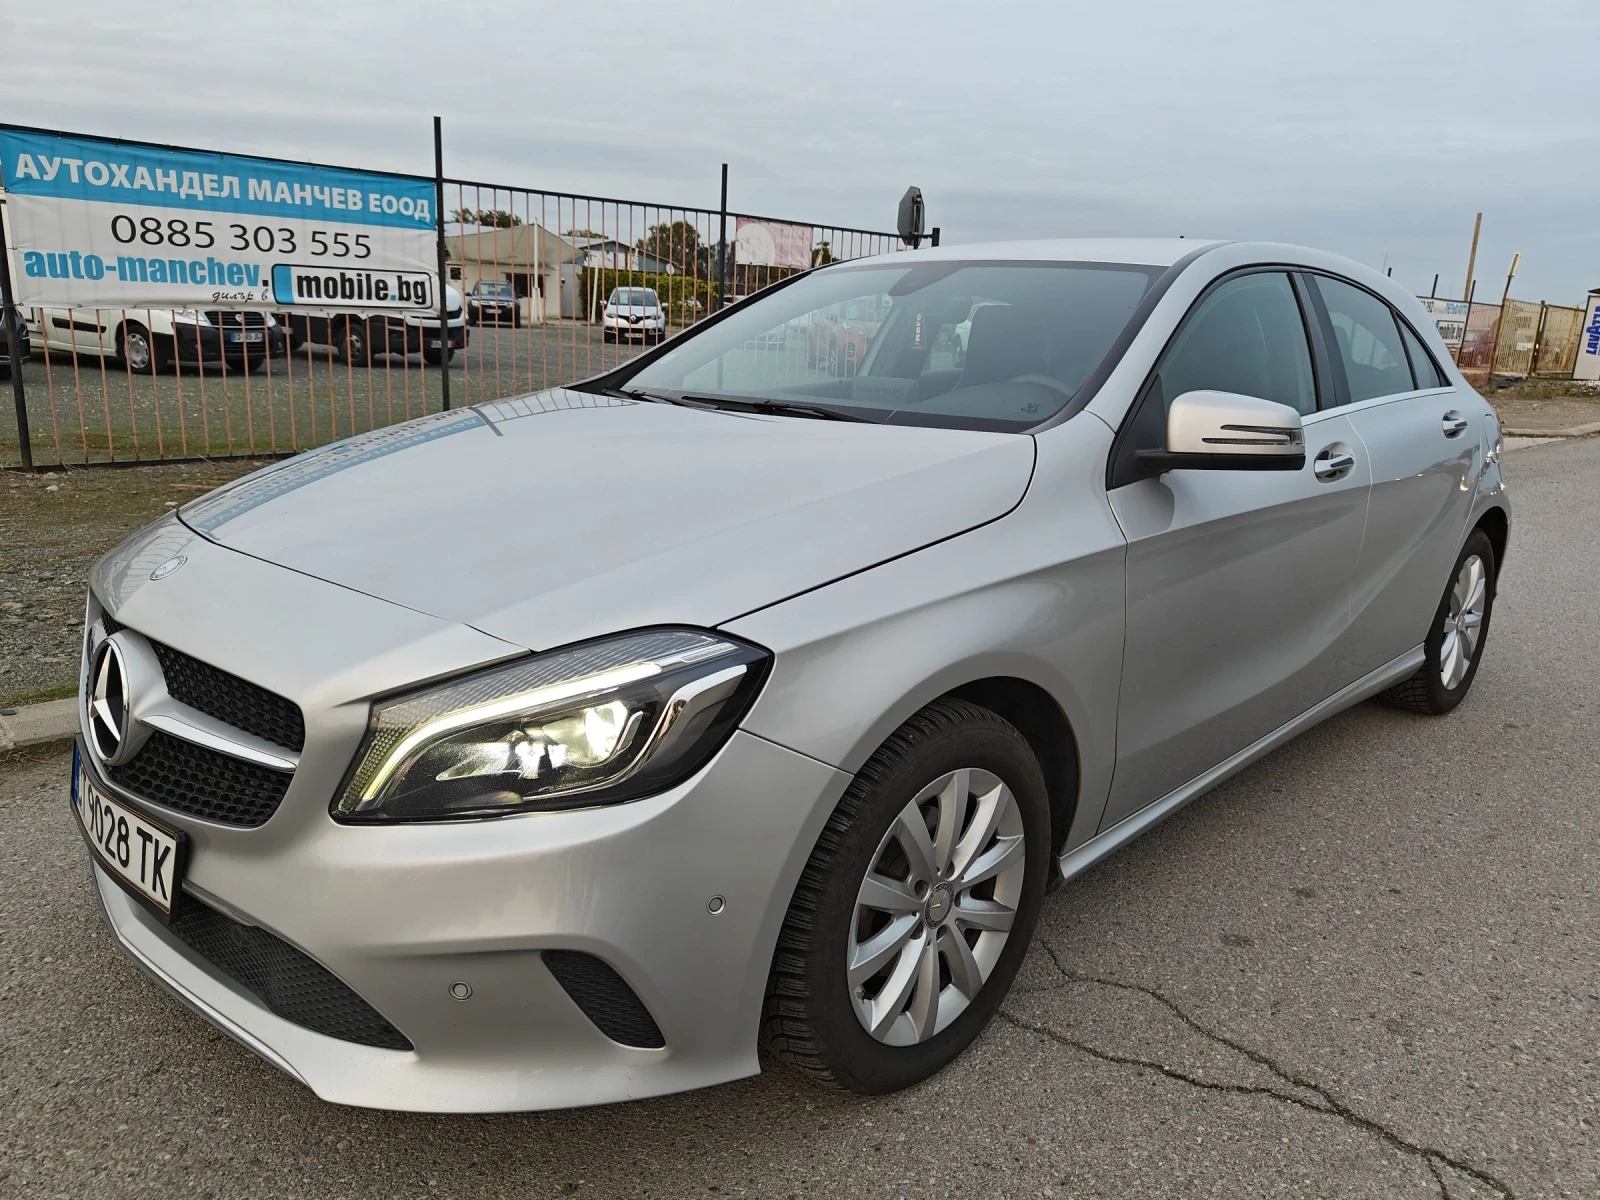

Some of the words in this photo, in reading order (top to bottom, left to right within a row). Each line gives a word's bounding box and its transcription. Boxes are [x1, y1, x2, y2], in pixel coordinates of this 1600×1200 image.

[15, 153, 240, 201] АУТОХАНДЕЛ
[248, 178, 363, 211] МАНЧЕВ
[369, 193, 431, 223] ЕООД
[111, 215, 215, 249] 0885
[229, 224, 297, 254] 303
[310, 231, 372, 259] 555
[297, 272, 427, 305] mobile.bg
[87, 784, 130, 868] 9028
[137, 825, 171, 902] TK
